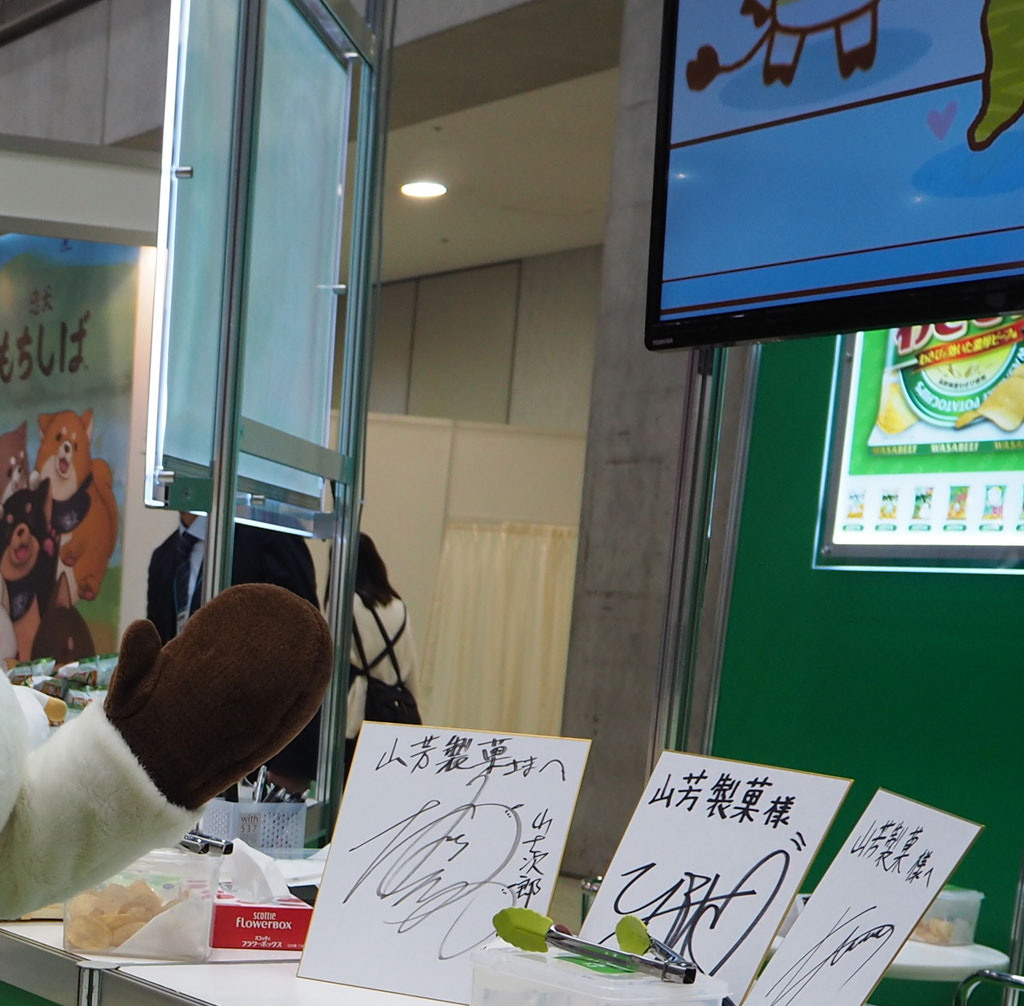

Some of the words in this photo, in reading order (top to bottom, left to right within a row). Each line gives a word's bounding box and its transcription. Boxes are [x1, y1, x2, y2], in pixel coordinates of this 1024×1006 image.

[931, 441, 979, 453] WASABEEF
[648, 769, 796, 829] 山芳製菓様
[241, 814, 259, 822] with
[242, 940, 283, 948] フラワーボックス
